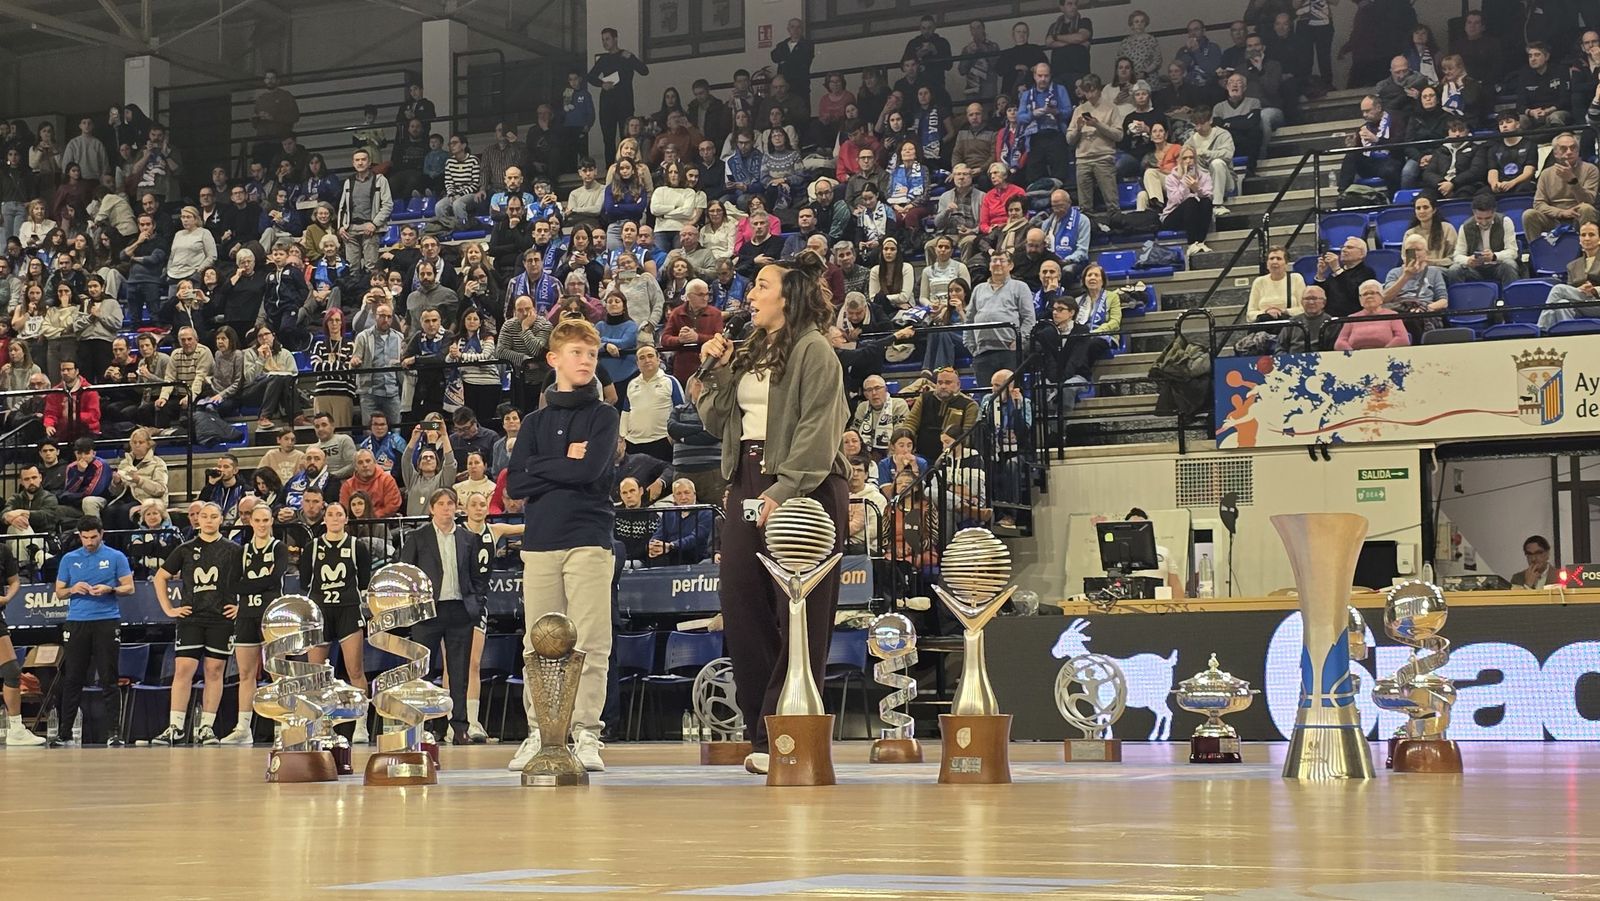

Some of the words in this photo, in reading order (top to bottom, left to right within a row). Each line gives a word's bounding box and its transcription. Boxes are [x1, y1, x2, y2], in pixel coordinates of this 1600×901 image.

[1576, 398, 1600, 418] de
[1361, 470, 1391, 480] SALIDA
[841, 569, 867, 585] om
[247, 594, 263, 607] 16
[323, 590, 341, 604] 22
